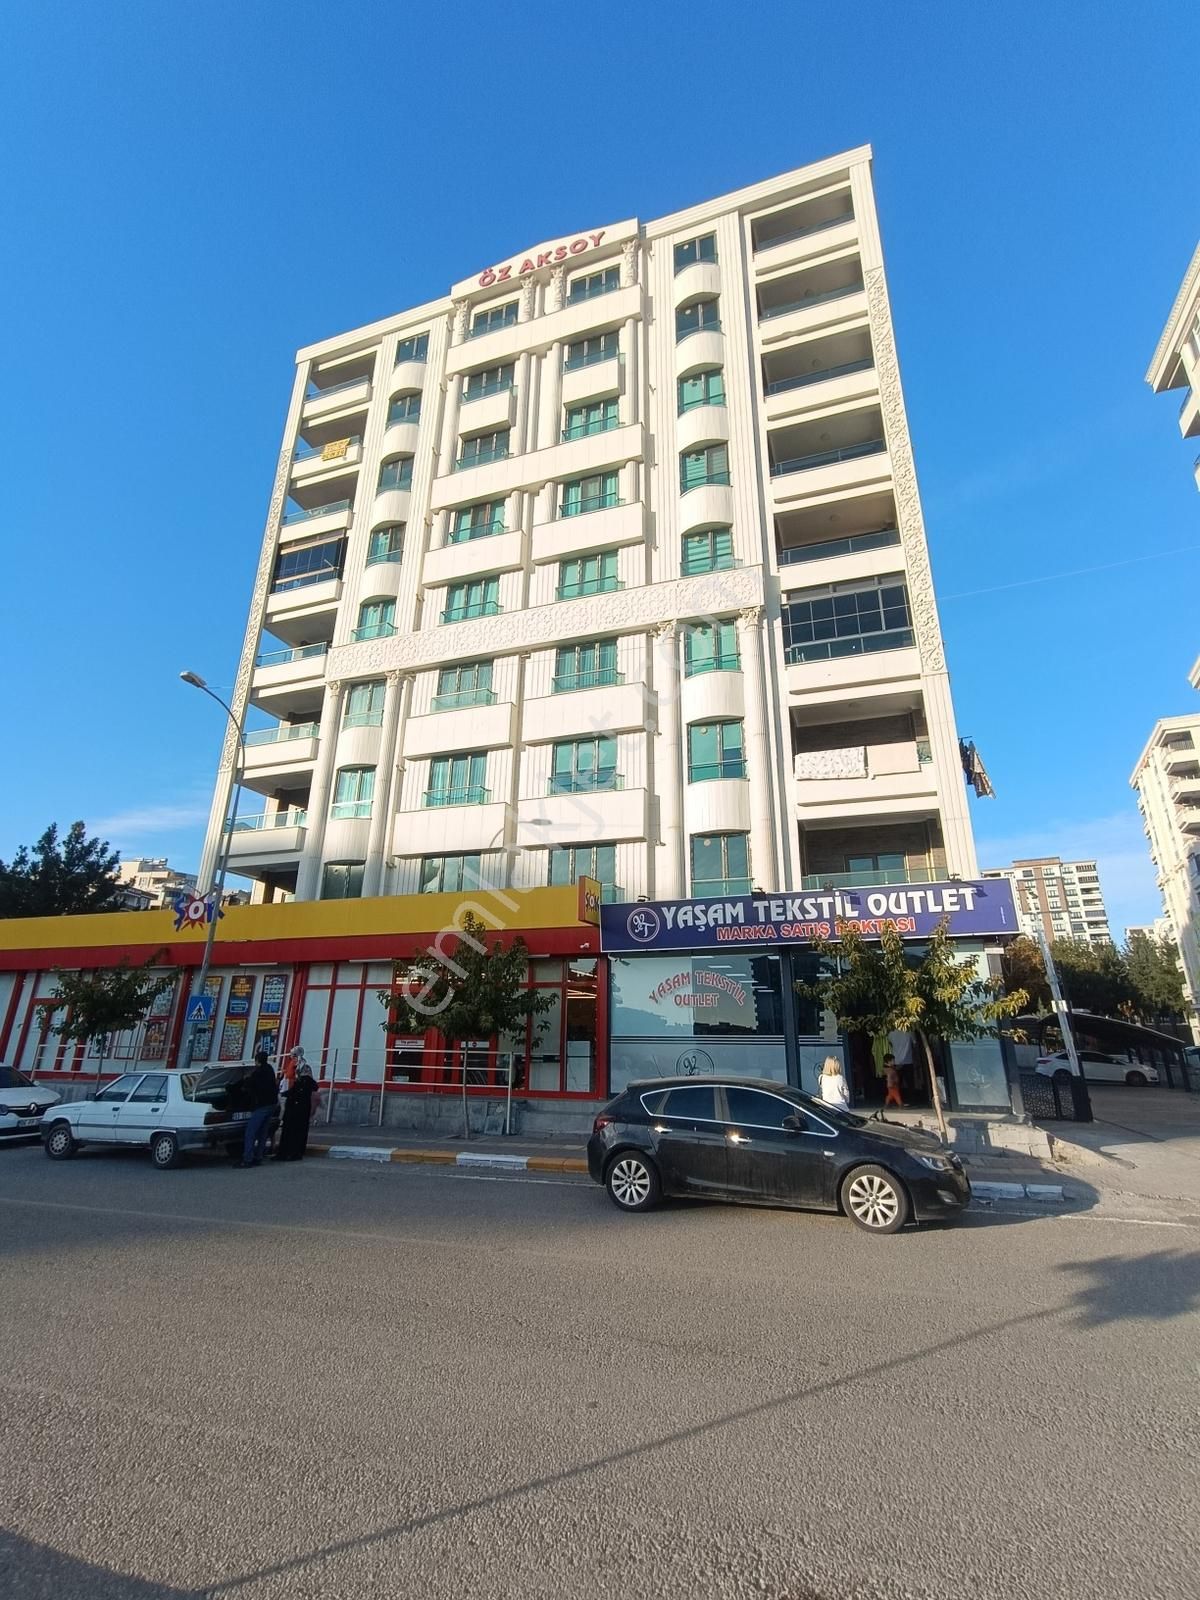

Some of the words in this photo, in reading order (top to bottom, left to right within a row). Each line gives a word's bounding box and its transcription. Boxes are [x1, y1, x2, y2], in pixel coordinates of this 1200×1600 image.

[478, 265, 512, 287] ÖZ
[519, 231, 606, 274] AKSOY
[661, 902, 744, 931] YAŞAM
[752, 891, 859, 922] TEKSTİL
[867, 887, 977, 917] OUTLET
[716, 924, 777, 941] MARKA
[781, 921, 831, 939] SATIŞ
[674, 993, 719, 1008] OUTLET
[695, 970, 746, 1006] TEKSTİL
